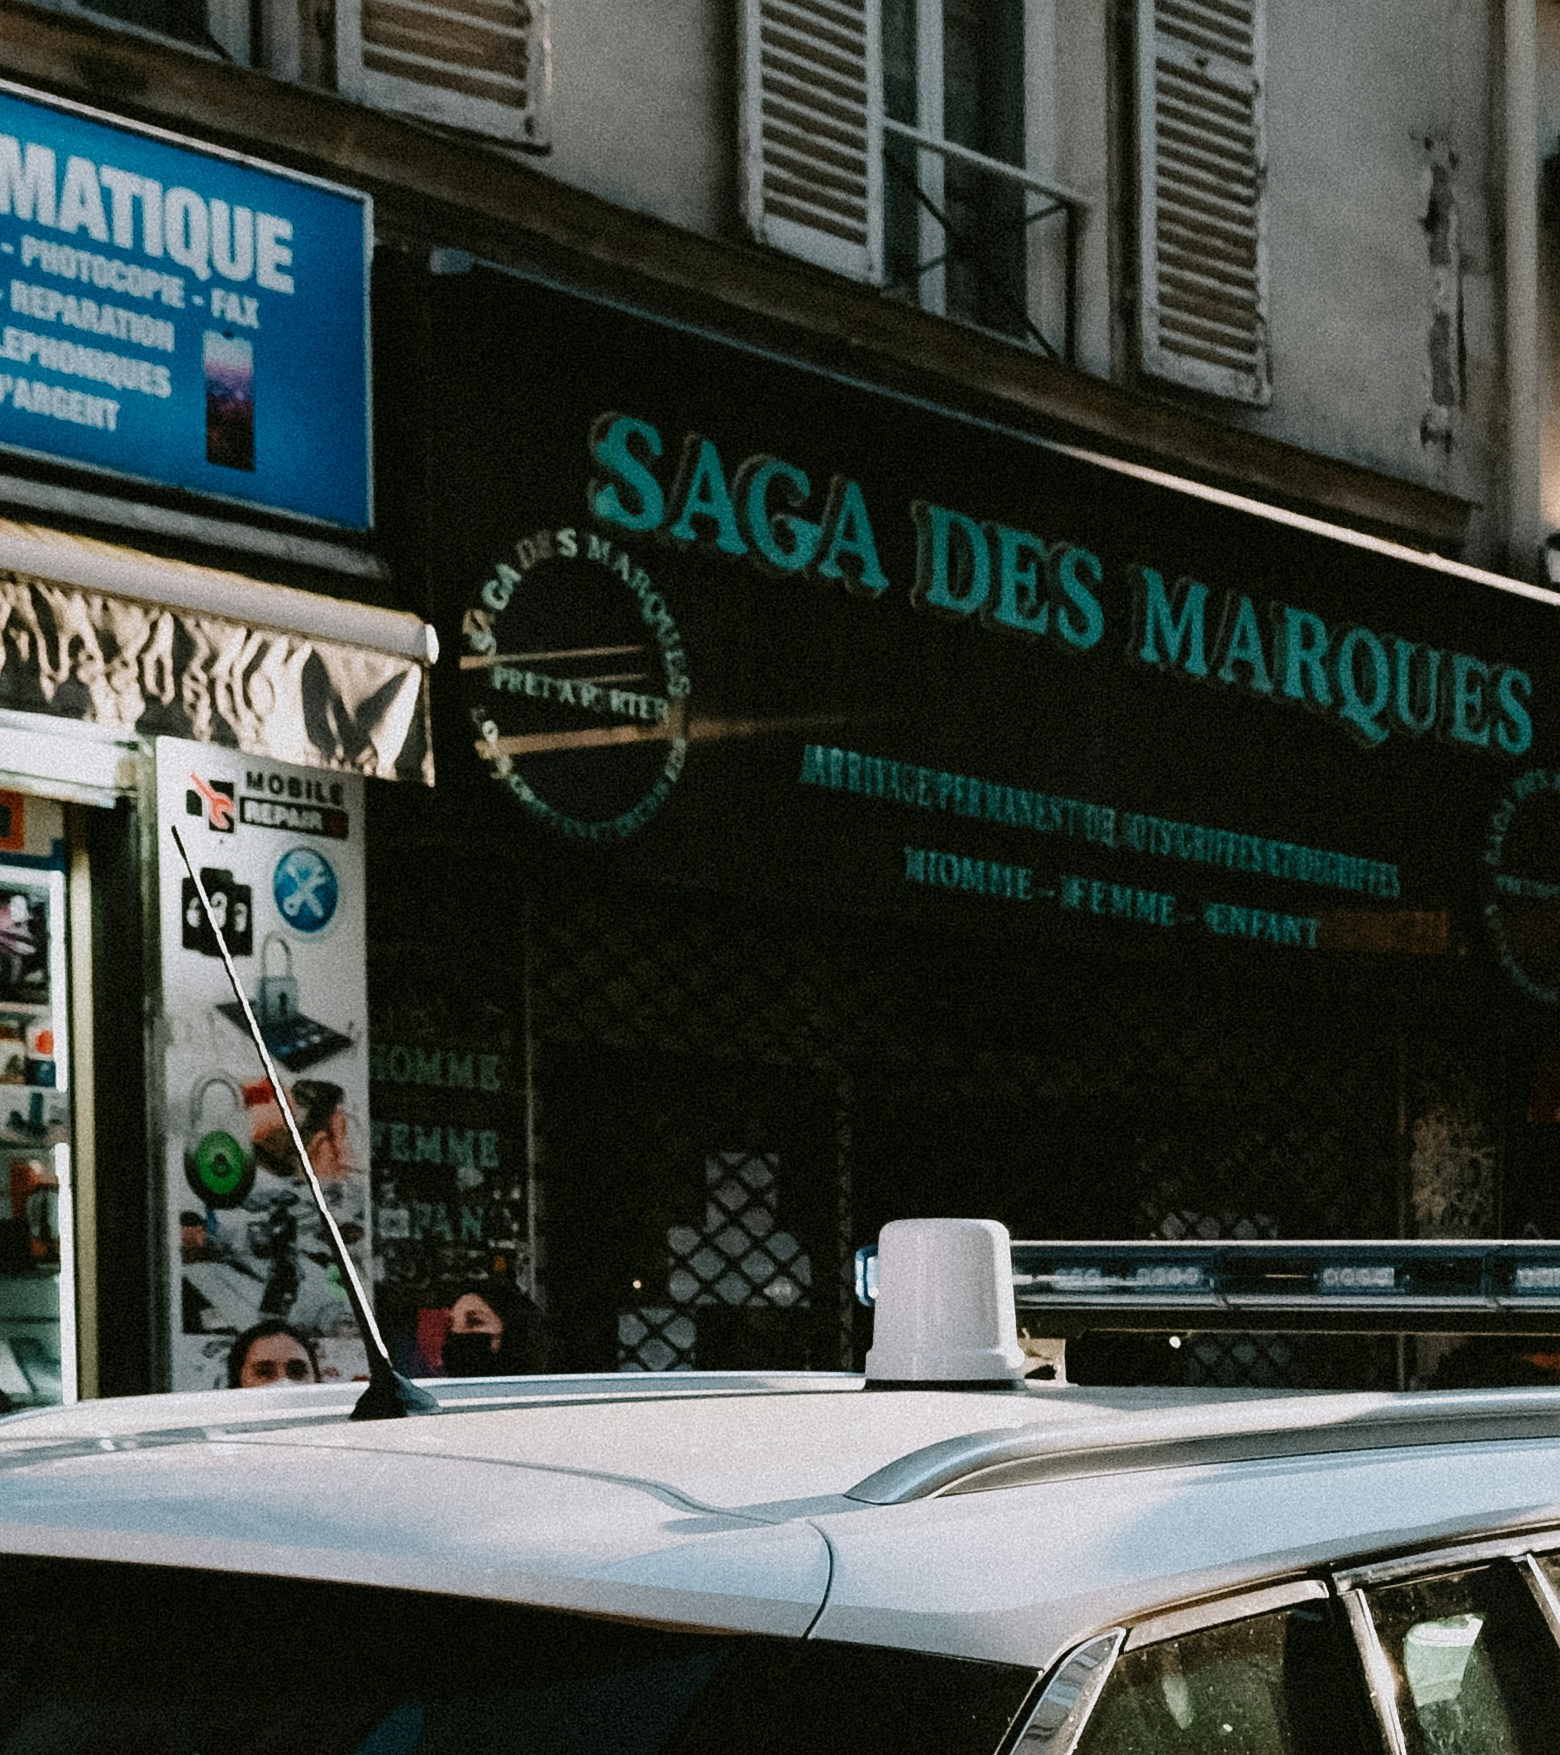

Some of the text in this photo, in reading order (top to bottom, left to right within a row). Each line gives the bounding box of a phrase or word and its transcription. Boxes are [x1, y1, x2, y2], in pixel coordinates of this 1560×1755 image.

[10, 279, 175, 352] REPARATION
[20, 235, 186, 309] PHOTOCOPIE
[211, 289, 260, 329] FAX
[590, 414, 1534, 757] SAGA DES MARQUES
[243, 802, 323, 832] REPAIR
[245, 771, 343, 806] MOBILE
